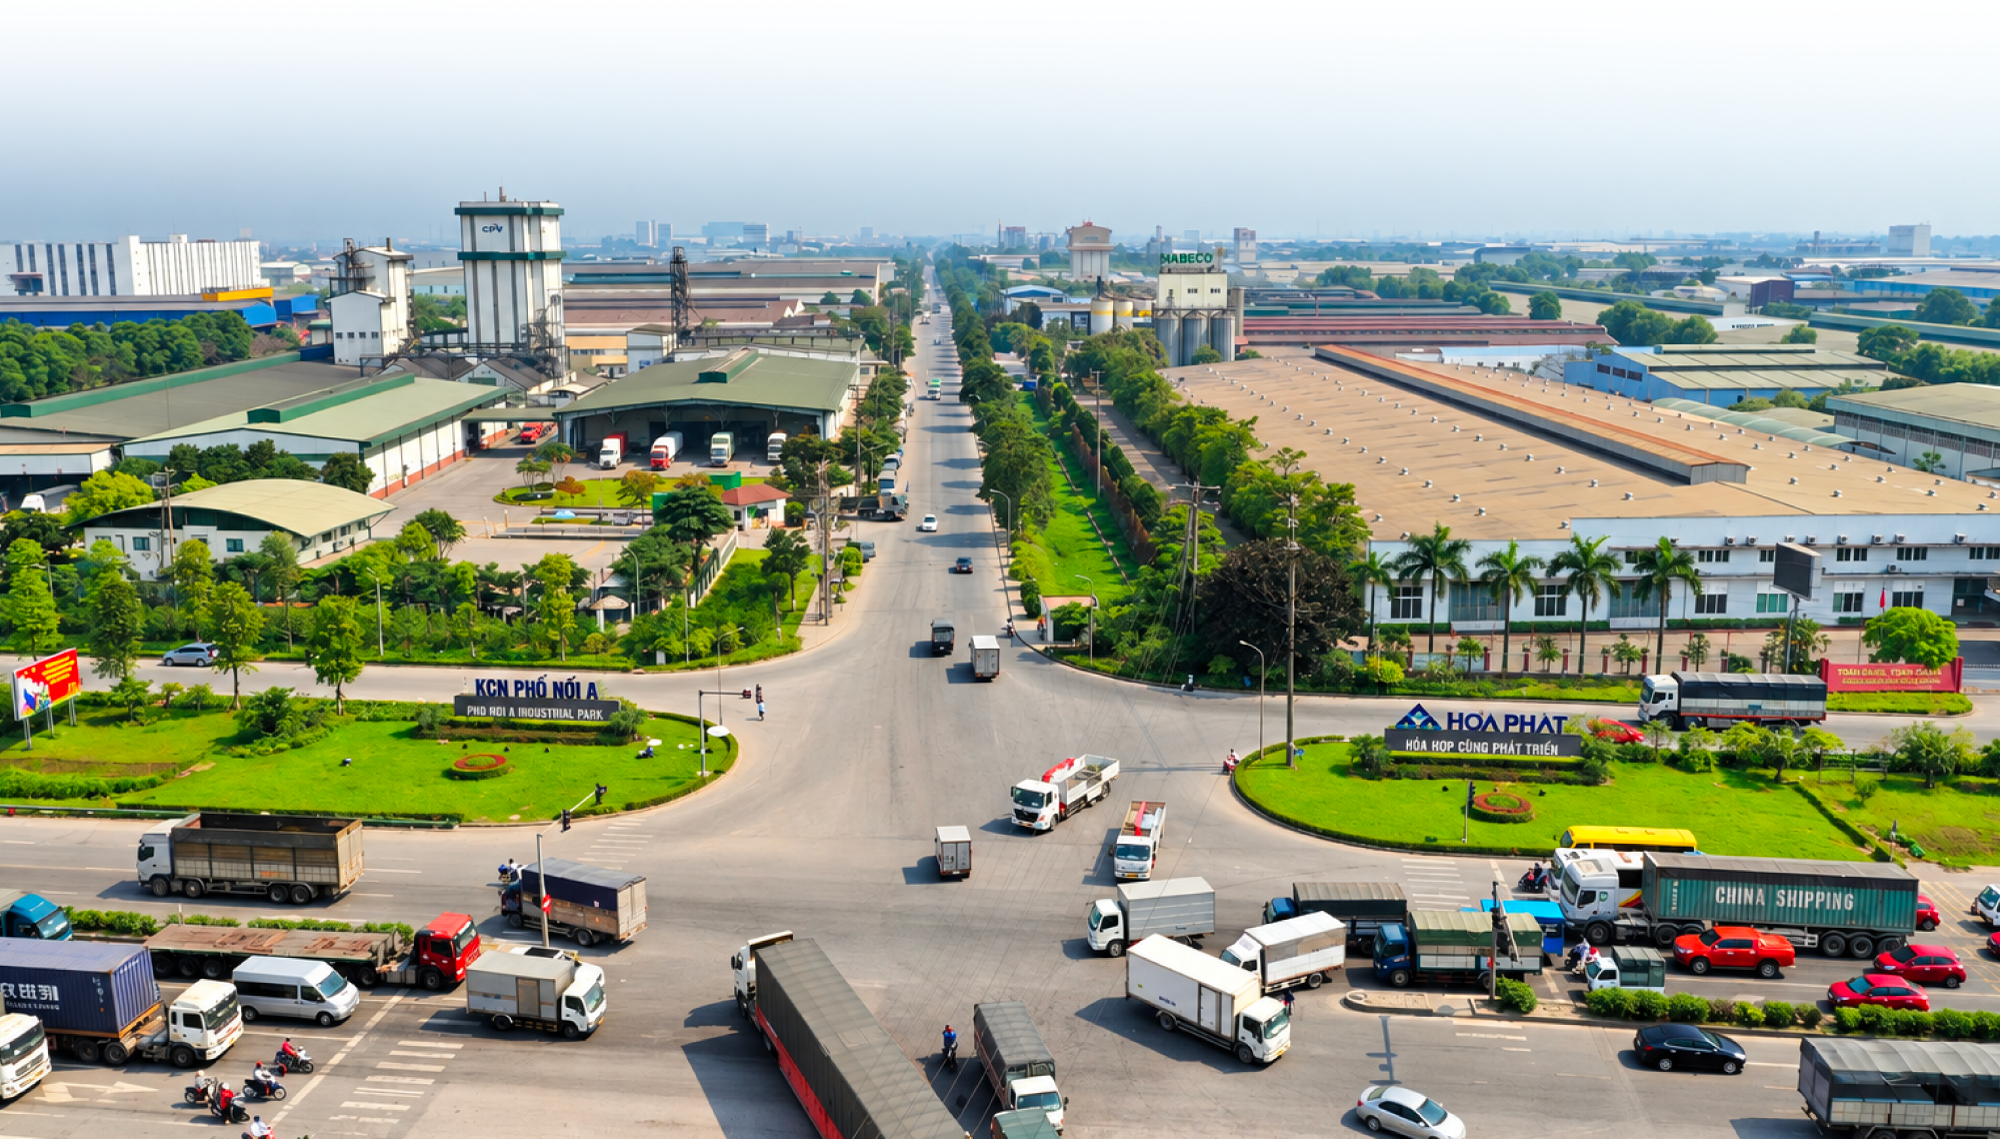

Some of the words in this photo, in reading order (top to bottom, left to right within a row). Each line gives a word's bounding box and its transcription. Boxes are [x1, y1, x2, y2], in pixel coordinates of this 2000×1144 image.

[475, 678, 509, 697] KCN
[514, 674, 548, 698] PHỐ
[553, 675, 581, 699] NỐI
[586, 682, 599, 700] A
[509, 706, 516, 717] A
[577, 708, 604, 720] PARK
[1715, 886, 1765, 906] CHINA
[1776, 889, 1854, 911] SHIPPING
